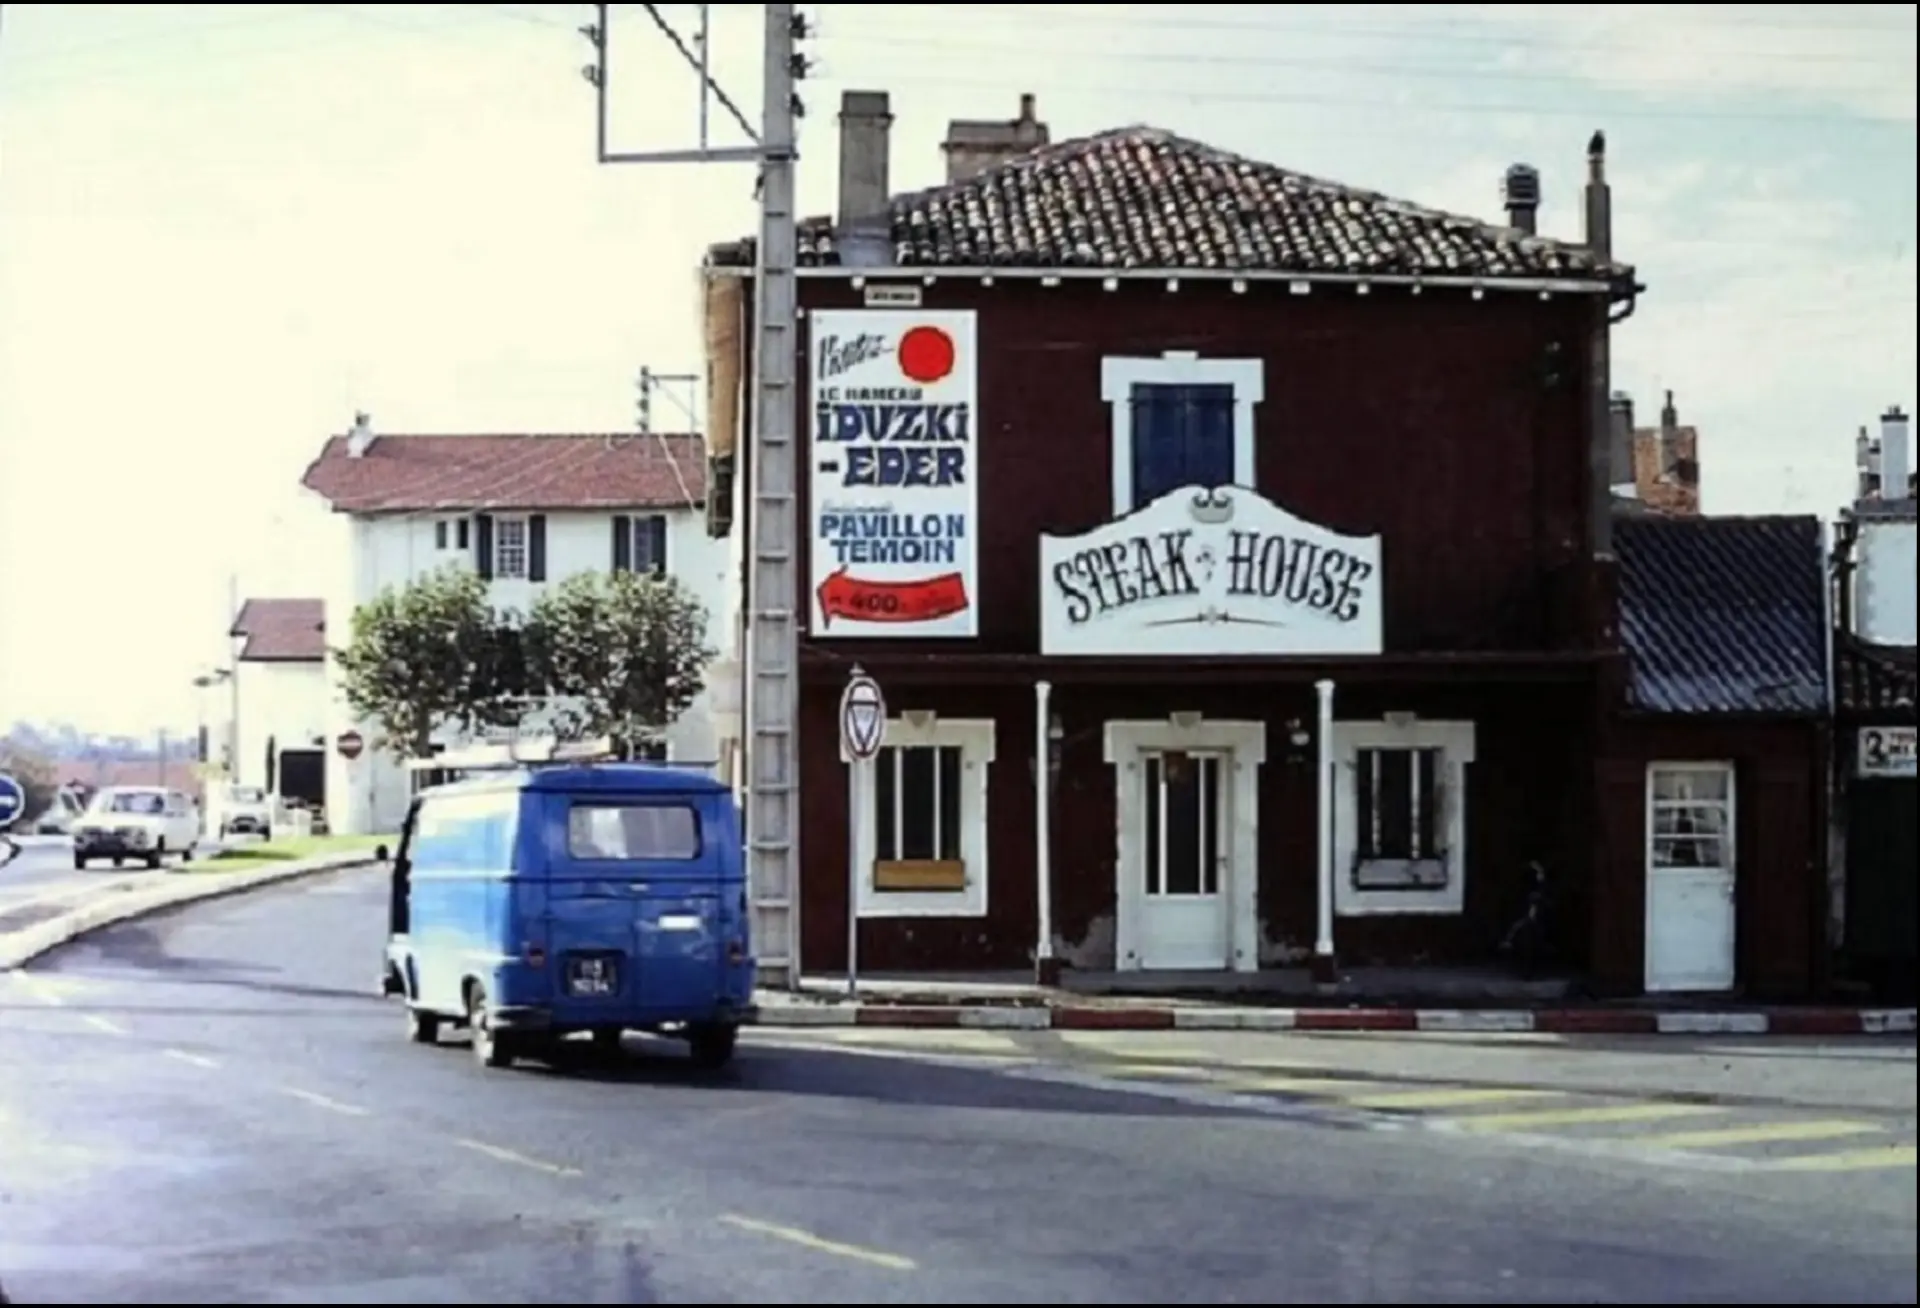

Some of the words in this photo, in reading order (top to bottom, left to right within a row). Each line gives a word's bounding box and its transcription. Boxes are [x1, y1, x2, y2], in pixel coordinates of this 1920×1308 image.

[819, 513, 965, 538] PAVILLON
[830, 539, 955, 564] TEMOIN
[1052, 529, 1200, 624] STEAK
[1226, 528, 1373, 622] HOUSE
